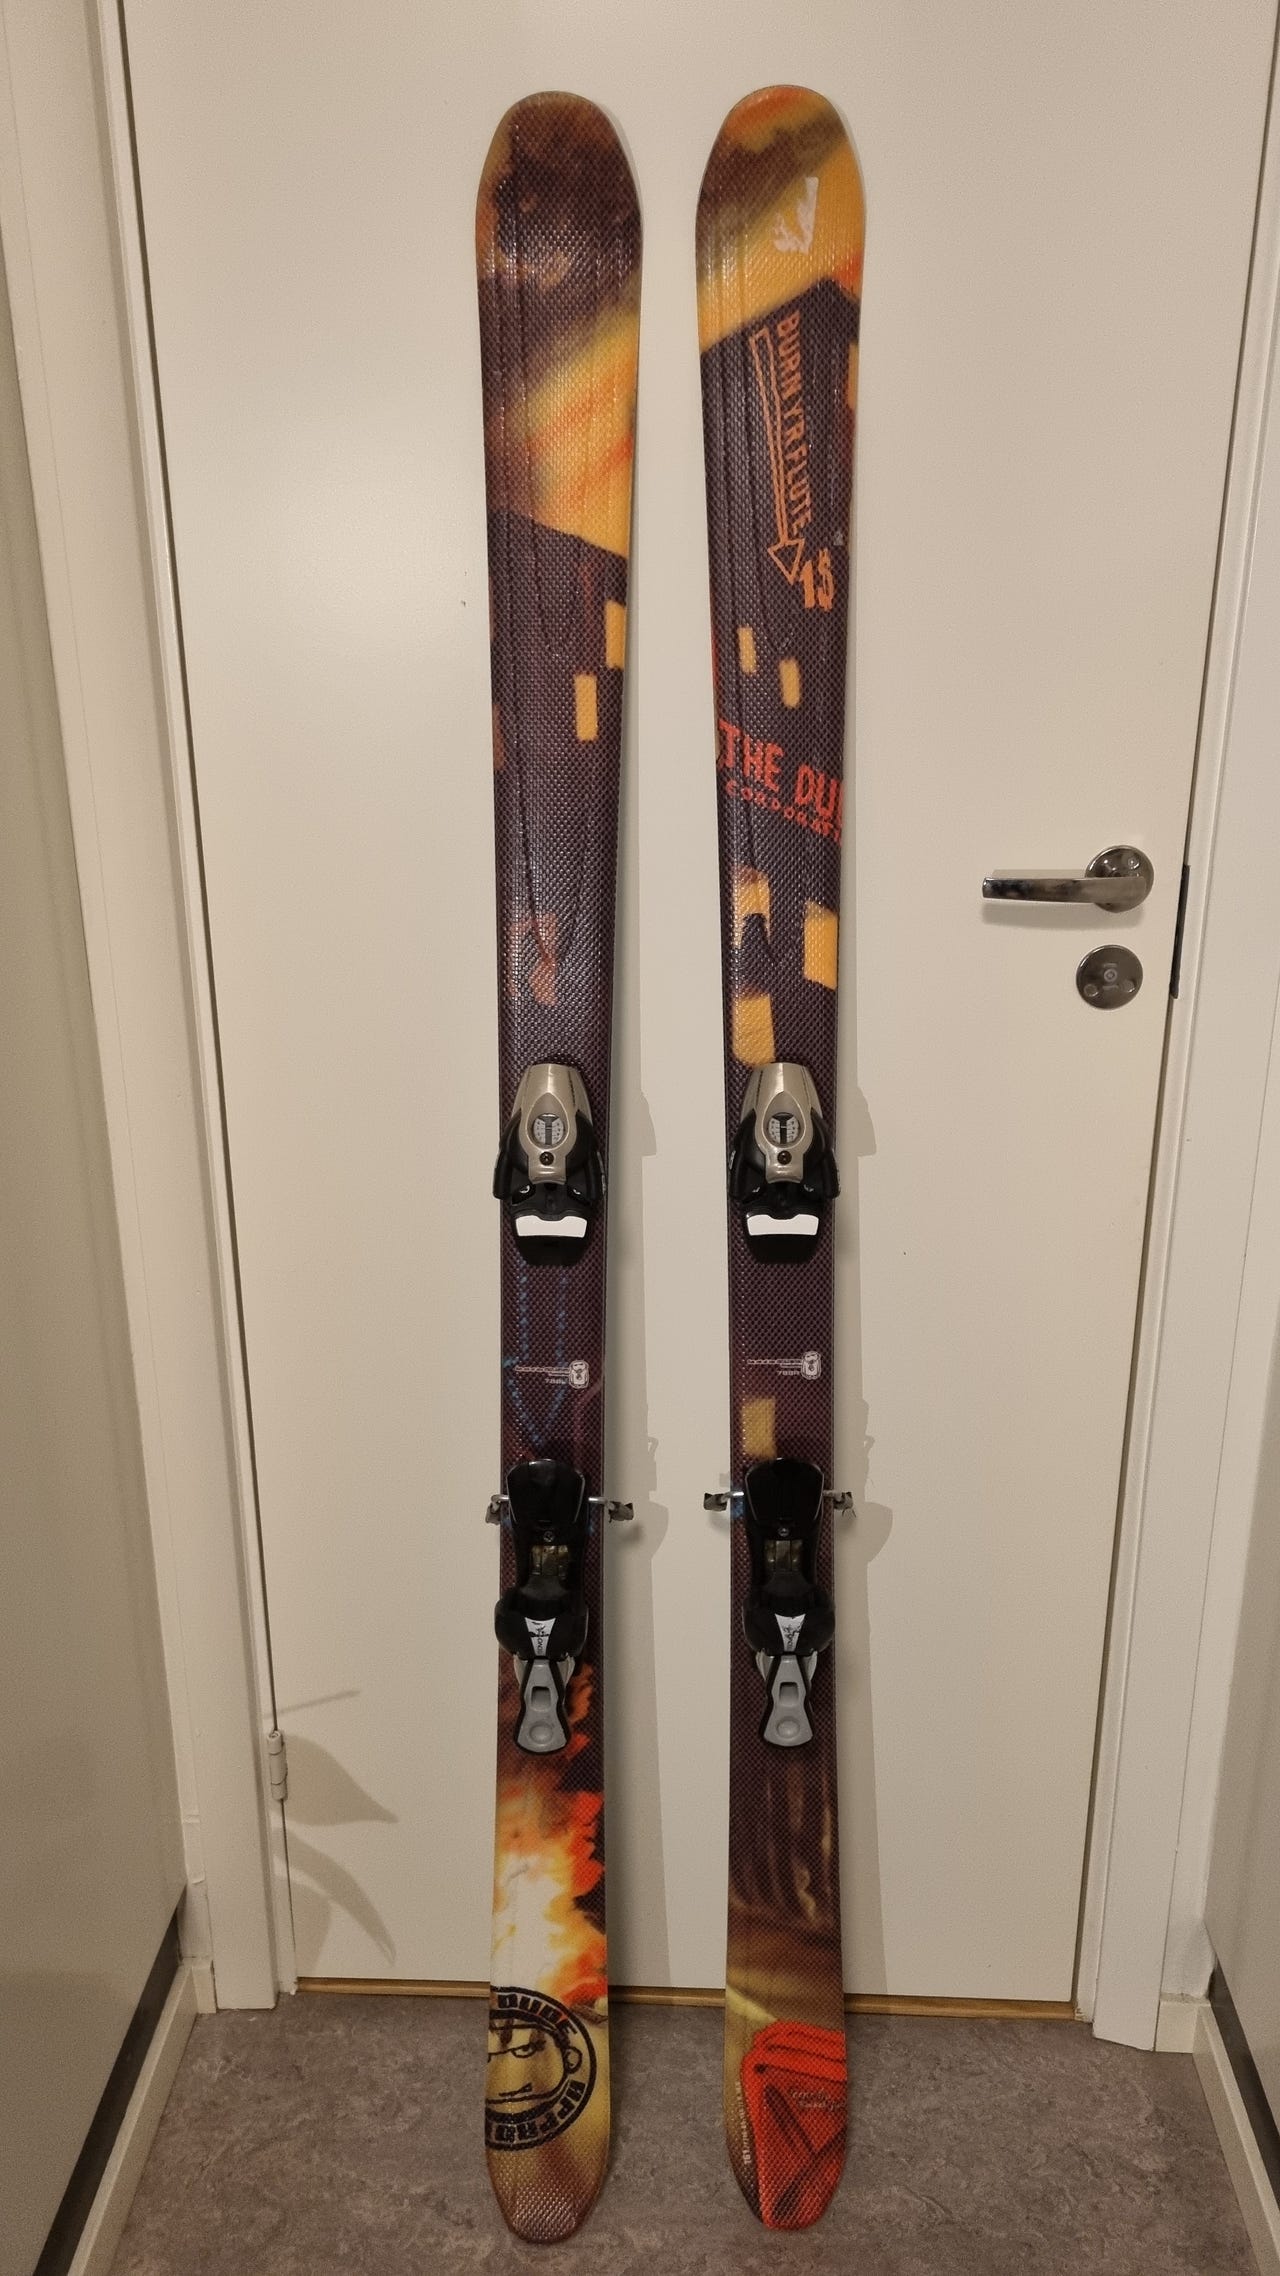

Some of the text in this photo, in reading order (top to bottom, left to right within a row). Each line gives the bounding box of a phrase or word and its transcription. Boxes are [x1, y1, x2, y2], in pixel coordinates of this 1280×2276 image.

[777, 309, 802, 400] BURN
[719, 718, 843, 828] THE DU
[497, 1993, 578, 2034] DUDE
